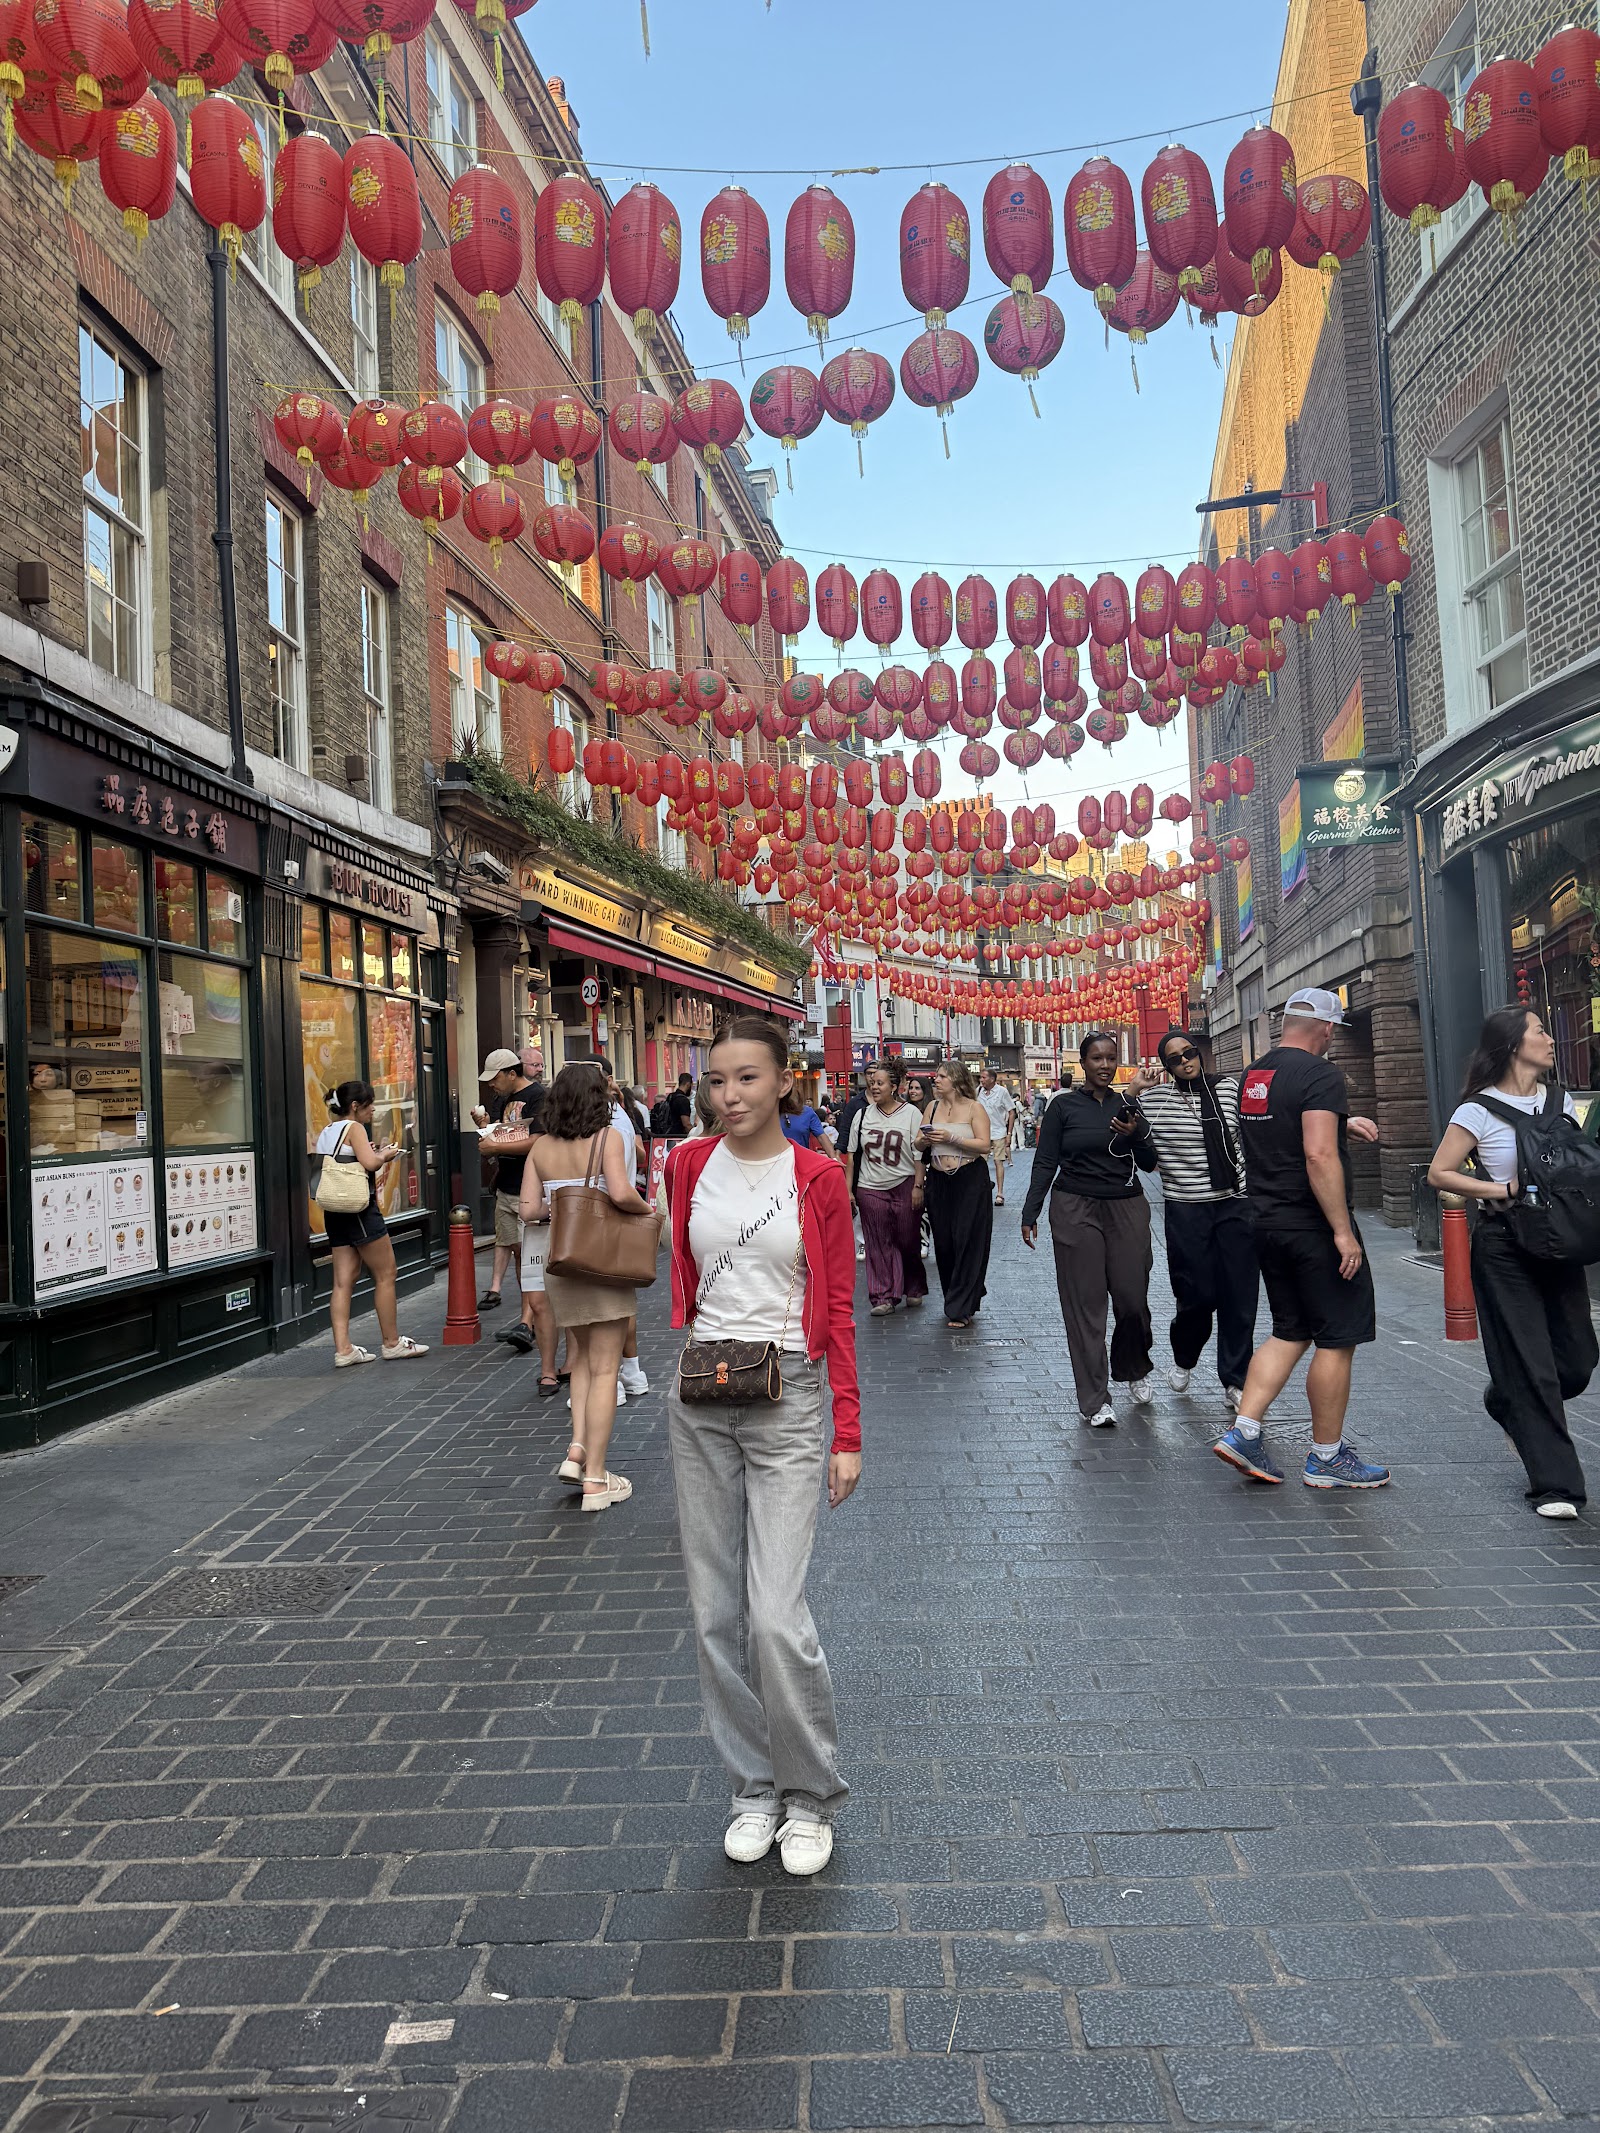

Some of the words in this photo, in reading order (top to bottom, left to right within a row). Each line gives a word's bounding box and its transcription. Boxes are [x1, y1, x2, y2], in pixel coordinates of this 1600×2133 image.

[1306, 829, 1356, 844] Gourmet
[1359, 824, 1401, 838] Kitchen
[1337, 821, 1363, 831] NEW
[331, 864, 363, 899] BUN
[367, 878, 414, 918] HOUSE
[525, 873, 559, 900] AWARD
[562, 888, 600, 917] WINNING
[601, 906, 617, 923] GAY
[617, 912, 632, 930] BAR
[660, 929, 685, 950] LICENSED
[583, 984, 598, 999] 20
[864, 1129, 904, 1168] 28
[34, 1175, 46, 1183] HOT
[46, 1173, 62, 1182] ASIAN
[110, 1222, 130, 1230] WONTON
[168, 1213, 185, 1221] SHARING
[738, 1194, 782, 1247] doesn't
